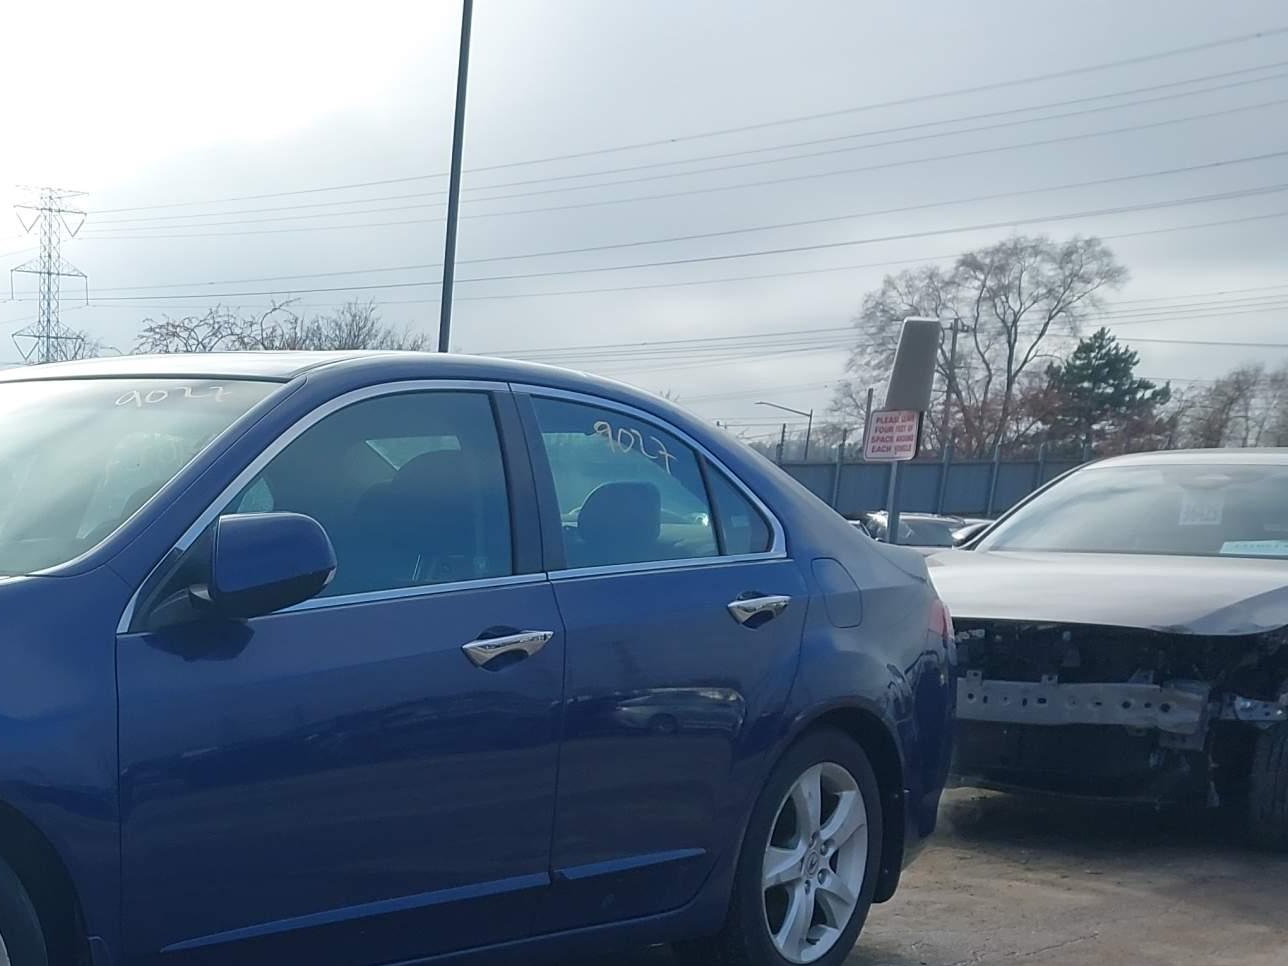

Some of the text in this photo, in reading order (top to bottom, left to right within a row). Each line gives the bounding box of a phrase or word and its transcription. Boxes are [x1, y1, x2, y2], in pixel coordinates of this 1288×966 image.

[114, 385, 232, 408] 9027
[876, 415, 900, 424] PLEASE
[874, 425, 894, 433] FOUR
[871, 435, 894, 443] SPACE
[593, 420, 679, 474] 9027
[871, 445, 892, 453] EACH
